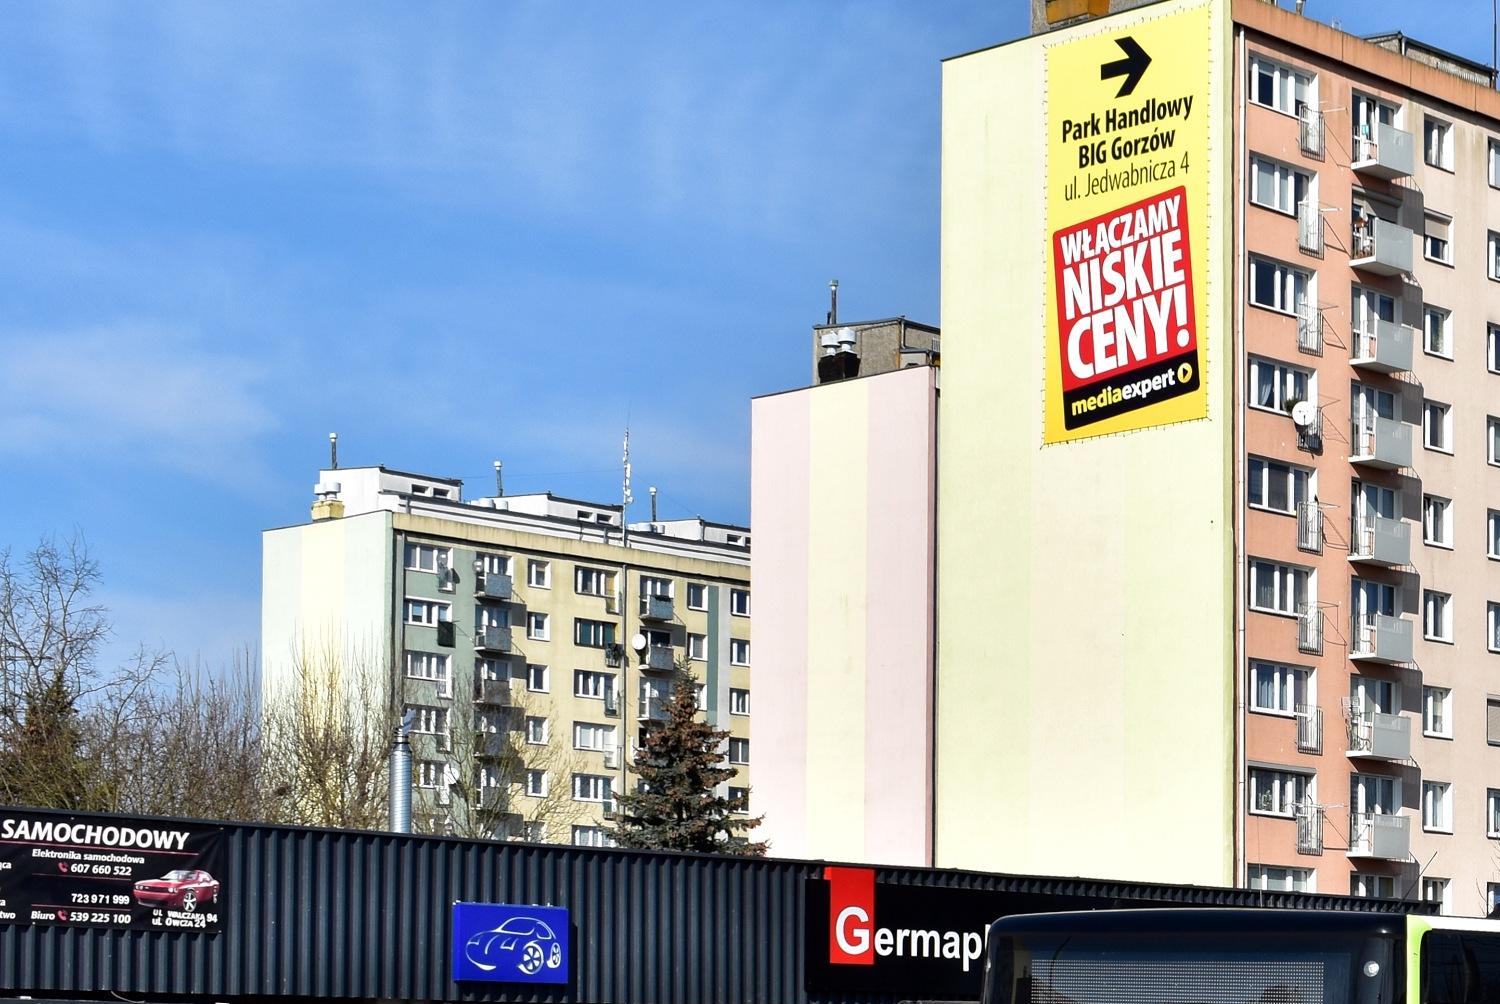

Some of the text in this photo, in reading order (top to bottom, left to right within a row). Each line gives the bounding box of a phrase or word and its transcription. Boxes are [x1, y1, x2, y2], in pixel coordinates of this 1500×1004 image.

[1062, 95, 1193, 143] Park Handlowy
[1079, 127, 1175, 169] BIG Gorzów
[1065, 151, 1190, 201] ul. Jedwabnicza 4
[1060, 195, 1181, 266] WŁĄCZAMY
[1063, 228, 1185, 320] NISKIE
[1067, 284, 1190, 379] CENY!
[1071, 368, 1175, 416] mediaexpert
[1, 819, 190, 850] SAMOCHODOWY
[32, 849, 145, 864] Elektronika samochodowa
[70, 864, 132, 876] 607 660 522
[31, 910, 131, 924] Biuro 539 225 100
[71, 893, 130, 904] 723 971 999
[206, 913, 218, 922] 94
